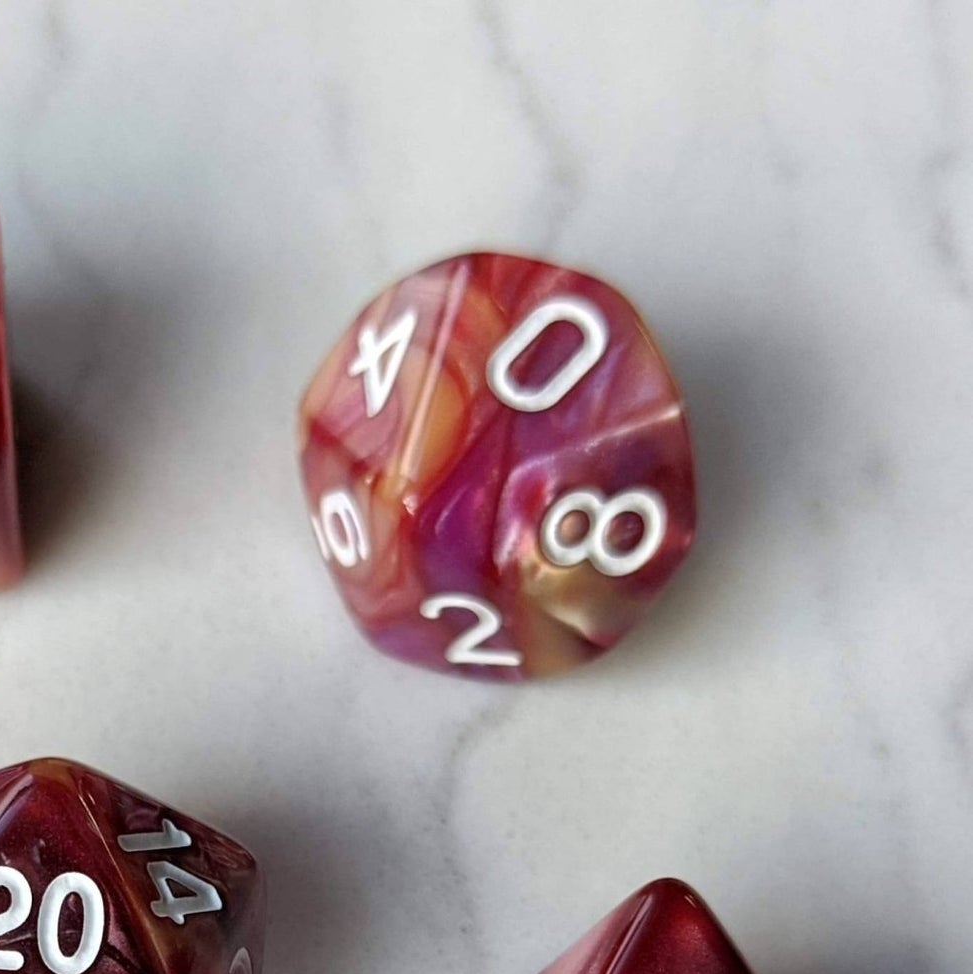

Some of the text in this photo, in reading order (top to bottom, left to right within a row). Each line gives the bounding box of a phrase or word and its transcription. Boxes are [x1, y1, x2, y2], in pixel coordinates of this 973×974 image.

[348, 310, 416, 417] 4
[487, 300, 608, 412] 0
[542, 489, 665, 577] 8
[420, 593, 522, 666] 2
[117, 818, 223, 925] 14
